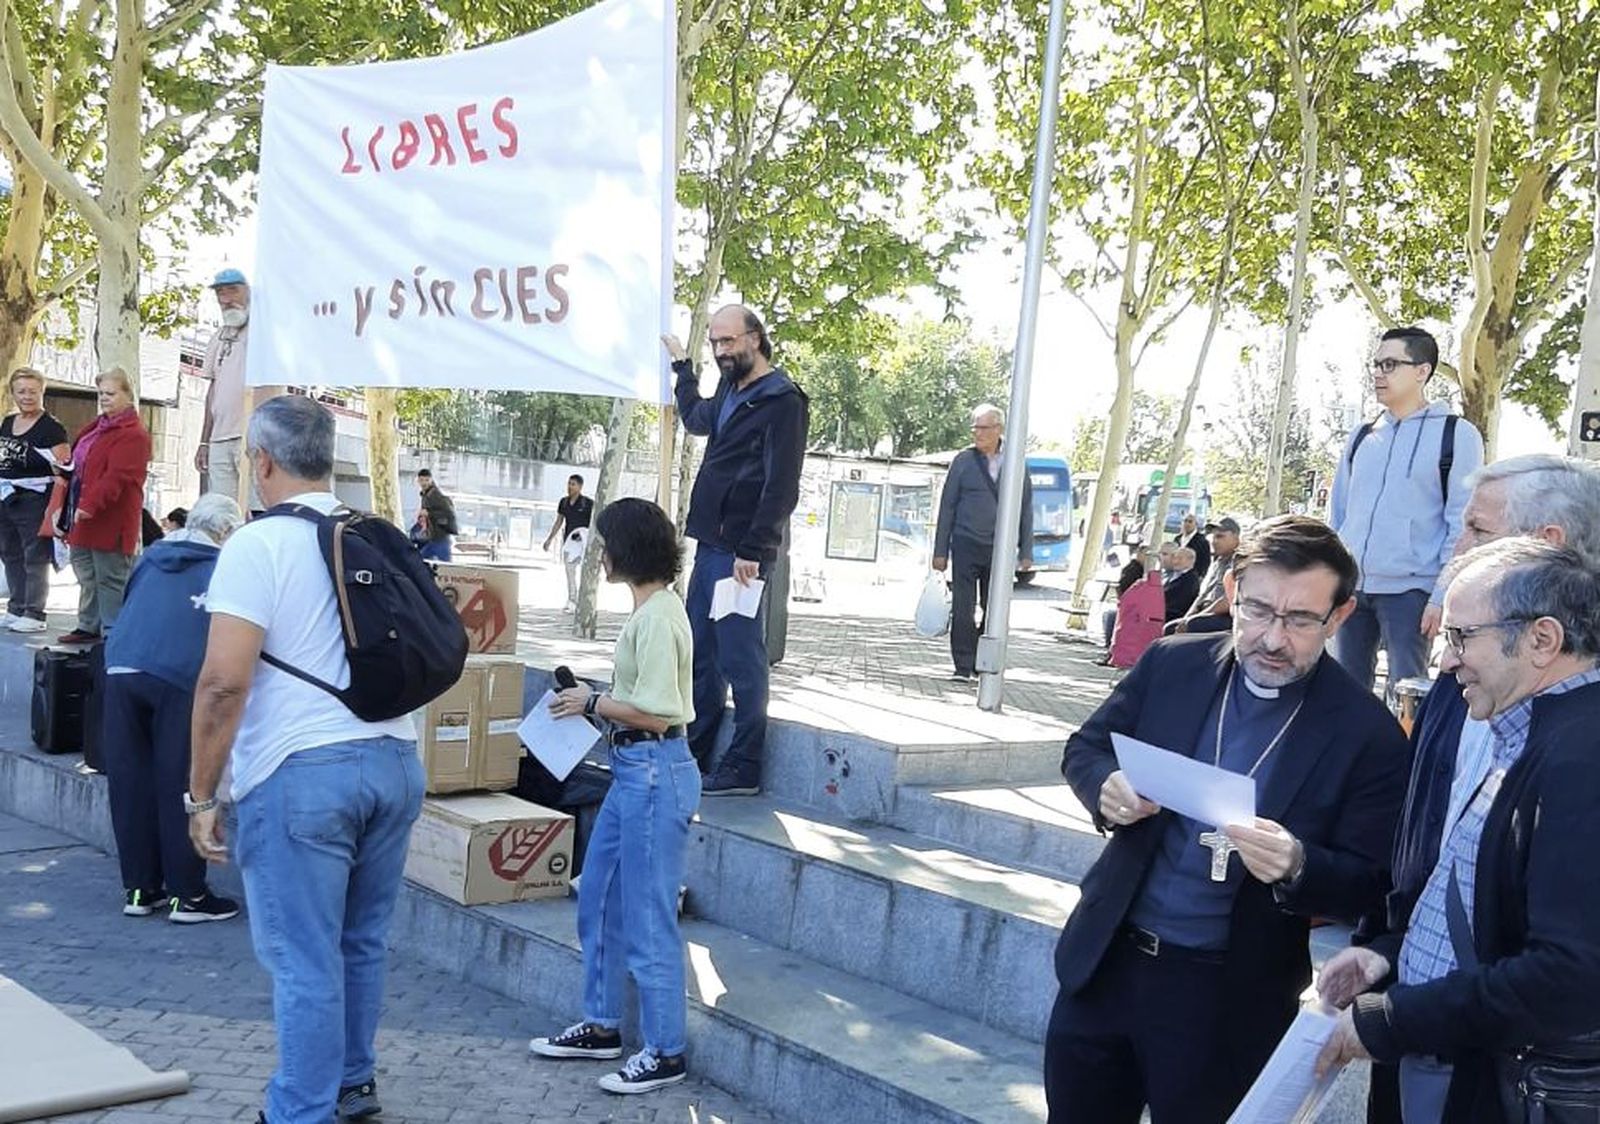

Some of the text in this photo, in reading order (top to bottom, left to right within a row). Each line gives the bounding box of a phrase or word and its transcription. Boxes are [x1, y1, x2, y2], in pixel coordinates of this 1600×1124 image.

[341, 96, 519, 174] LIBRES
[388, 265, 456, 320] sin
[470, 264, 570, 324] CIES
